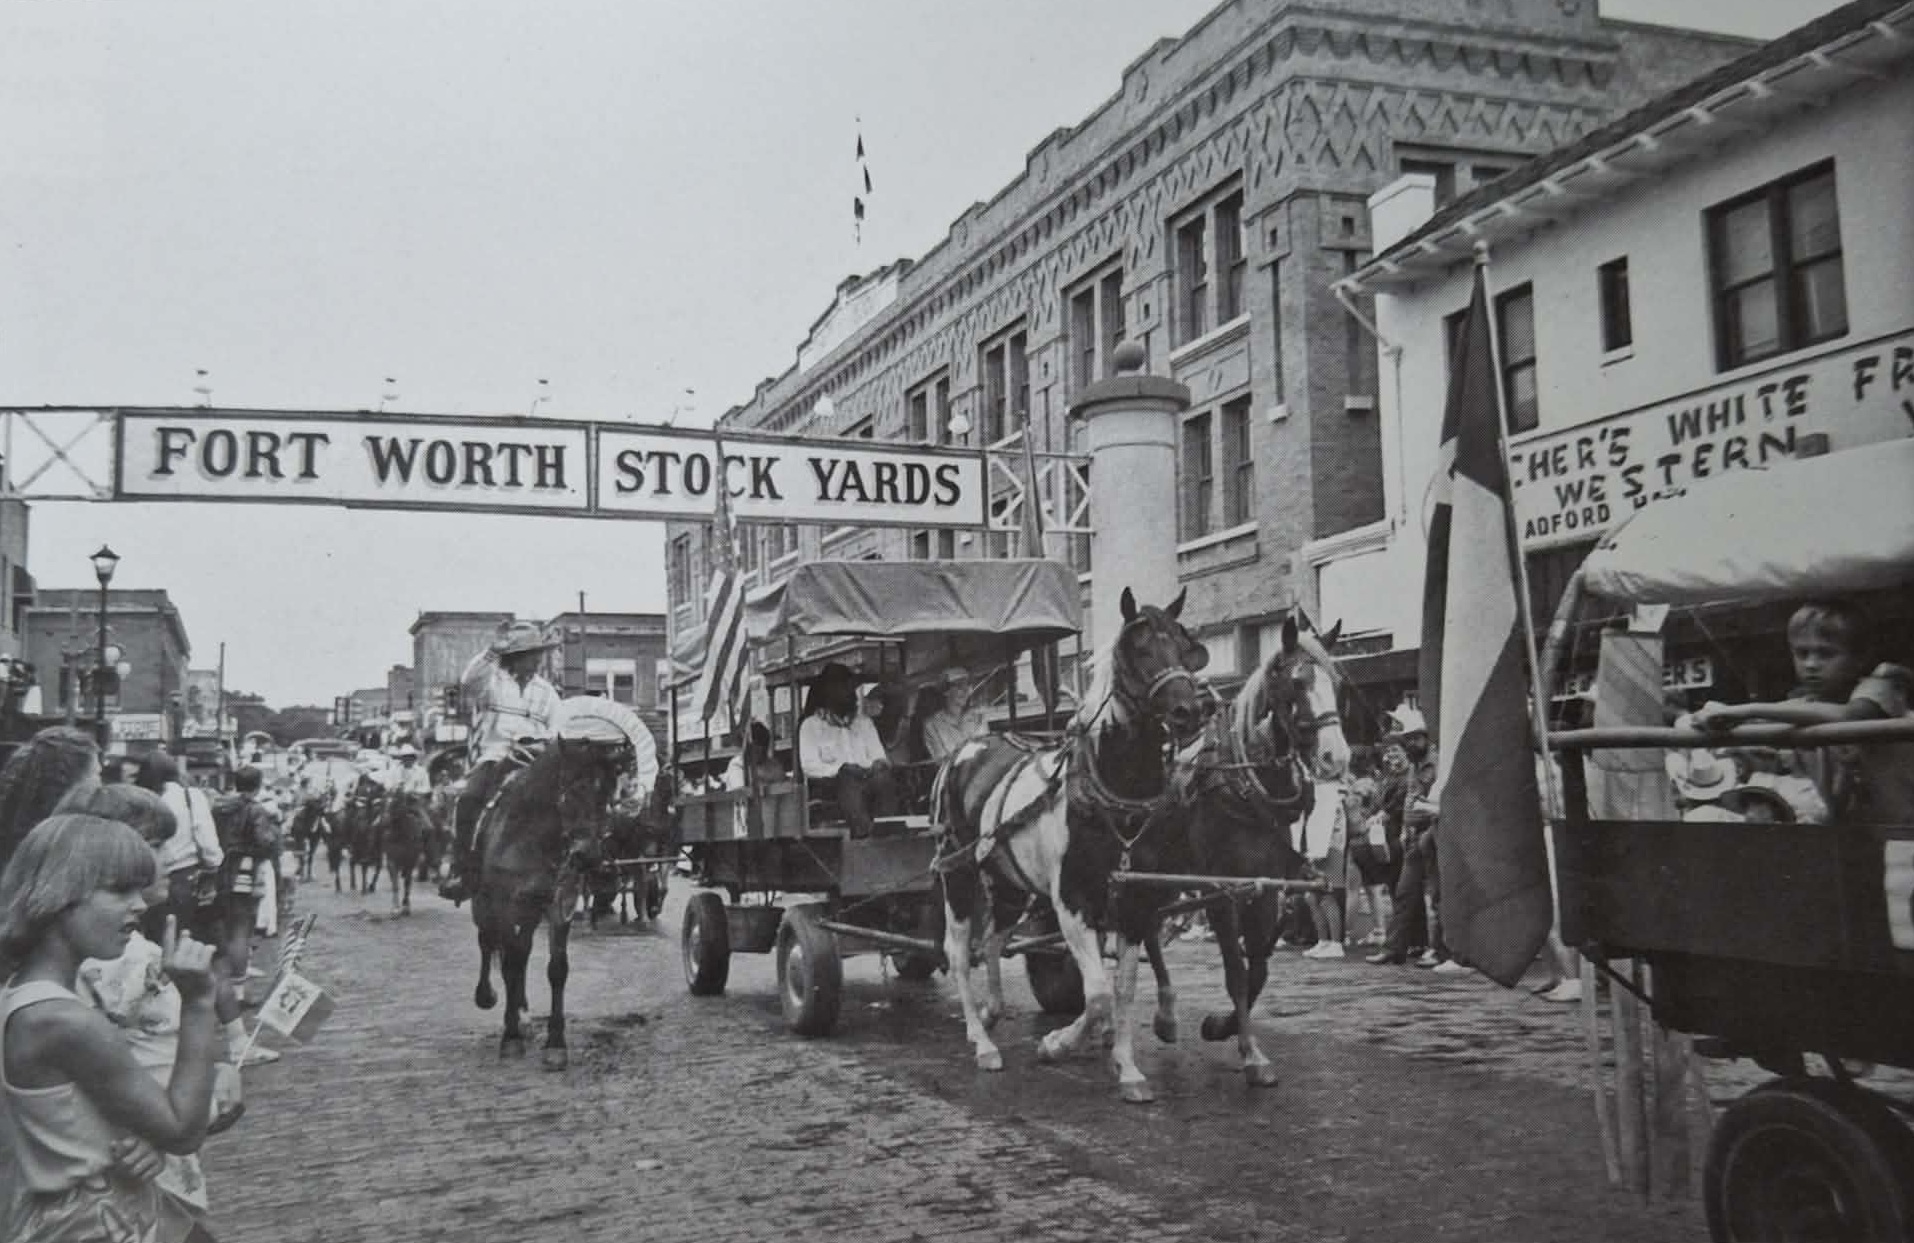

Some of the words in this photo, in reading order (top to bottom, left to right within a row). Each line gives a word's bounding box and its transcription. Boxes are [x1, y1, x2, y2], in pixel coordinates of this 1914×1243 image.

[1668, 374, 1810, 446] WHITE
[153, 427, 331, 480] FORT
[366, 435, 569, 490] WORTH
[616, 450, 783, 499] STOCK
[808, 457, 961, 507] YARDS
[1555, 425, 1796, 510] WESTERN
[1524, 504, 1610, 539] ADFORD
